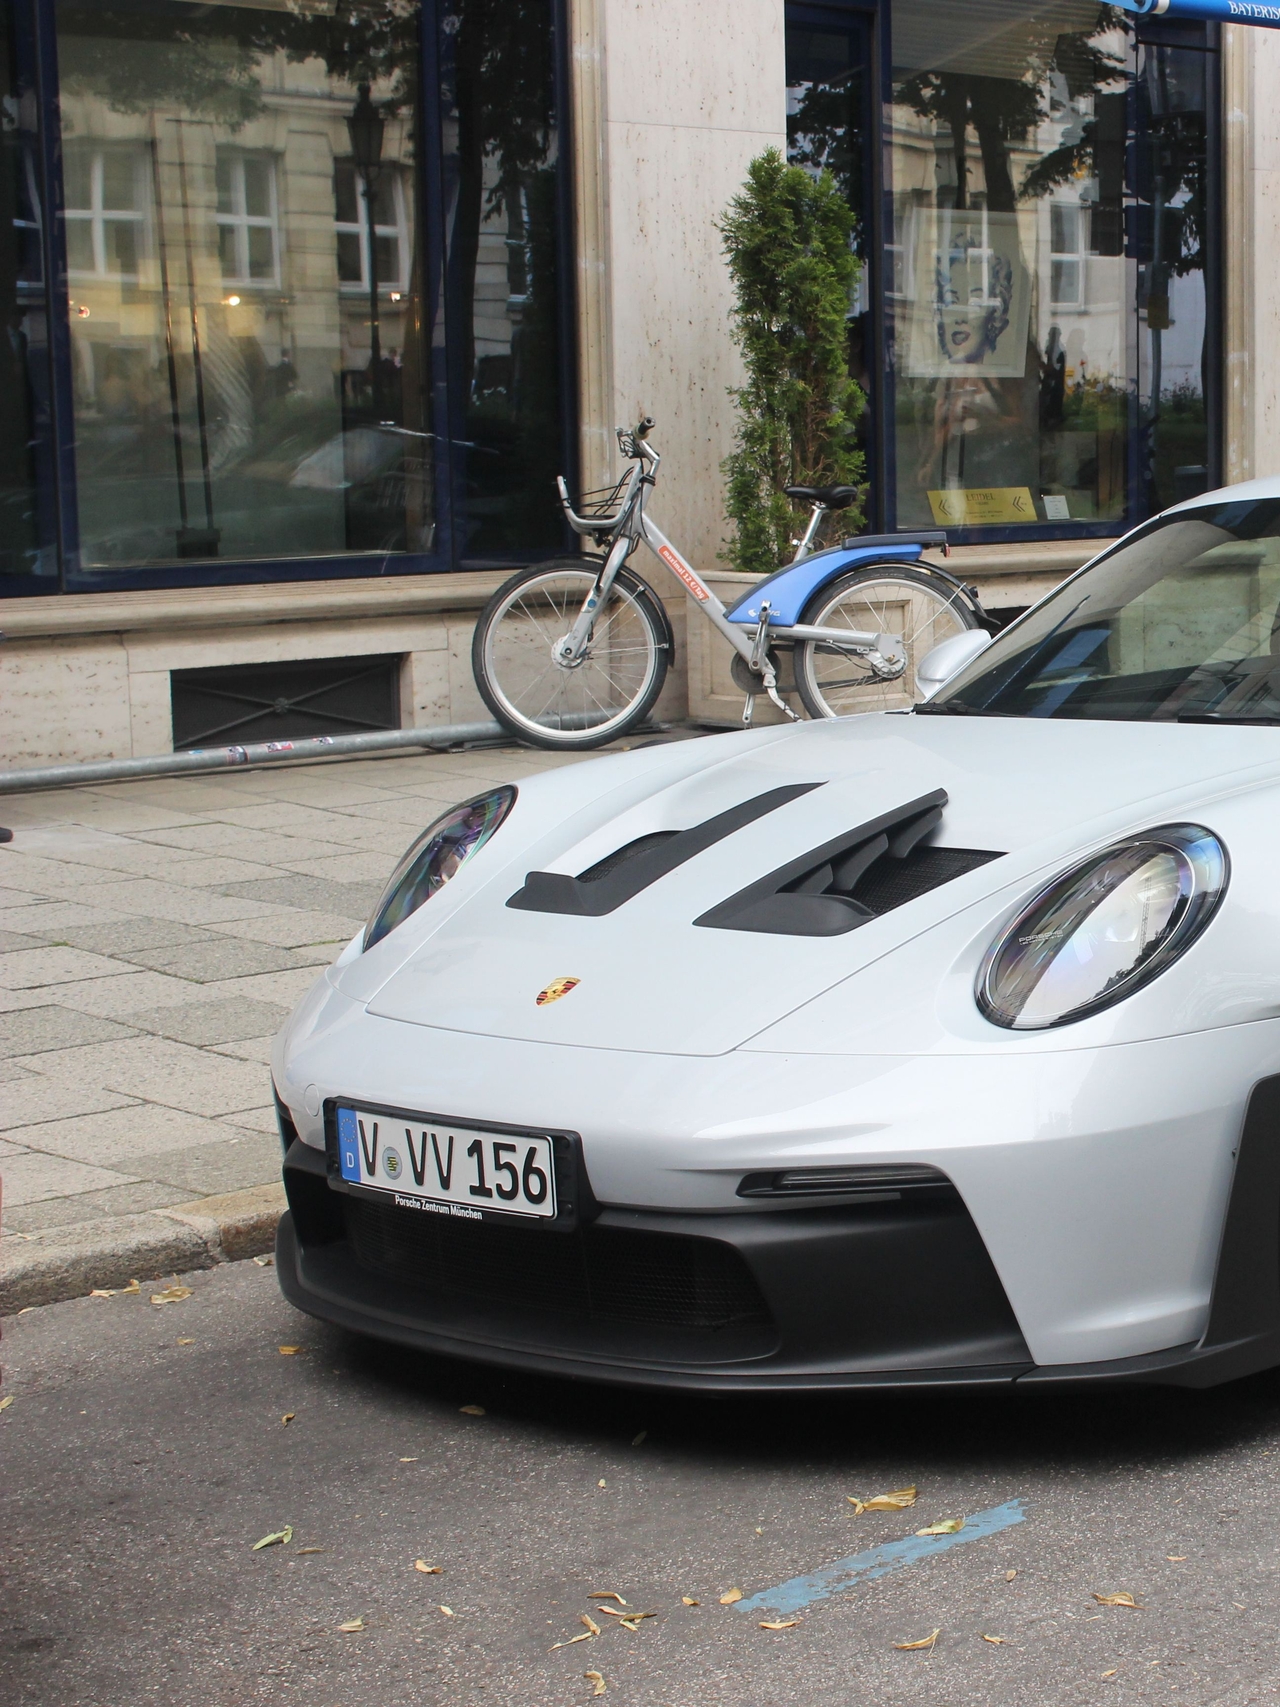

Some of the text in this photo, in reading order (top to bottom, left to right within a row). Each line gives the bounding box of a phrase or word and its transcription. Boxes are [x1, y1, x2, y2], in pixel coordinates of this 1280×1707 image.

[965, 492, 996, 502] LEIDEL
[662, 550, 686, 576] maximal
[682, 573, 692, 583] 12
[346, 1152, 355, 1168] D
[358, 1119, 548, 1205] V VV 156
[395, 1194, 483, 1220] Porsche Zentrum München
